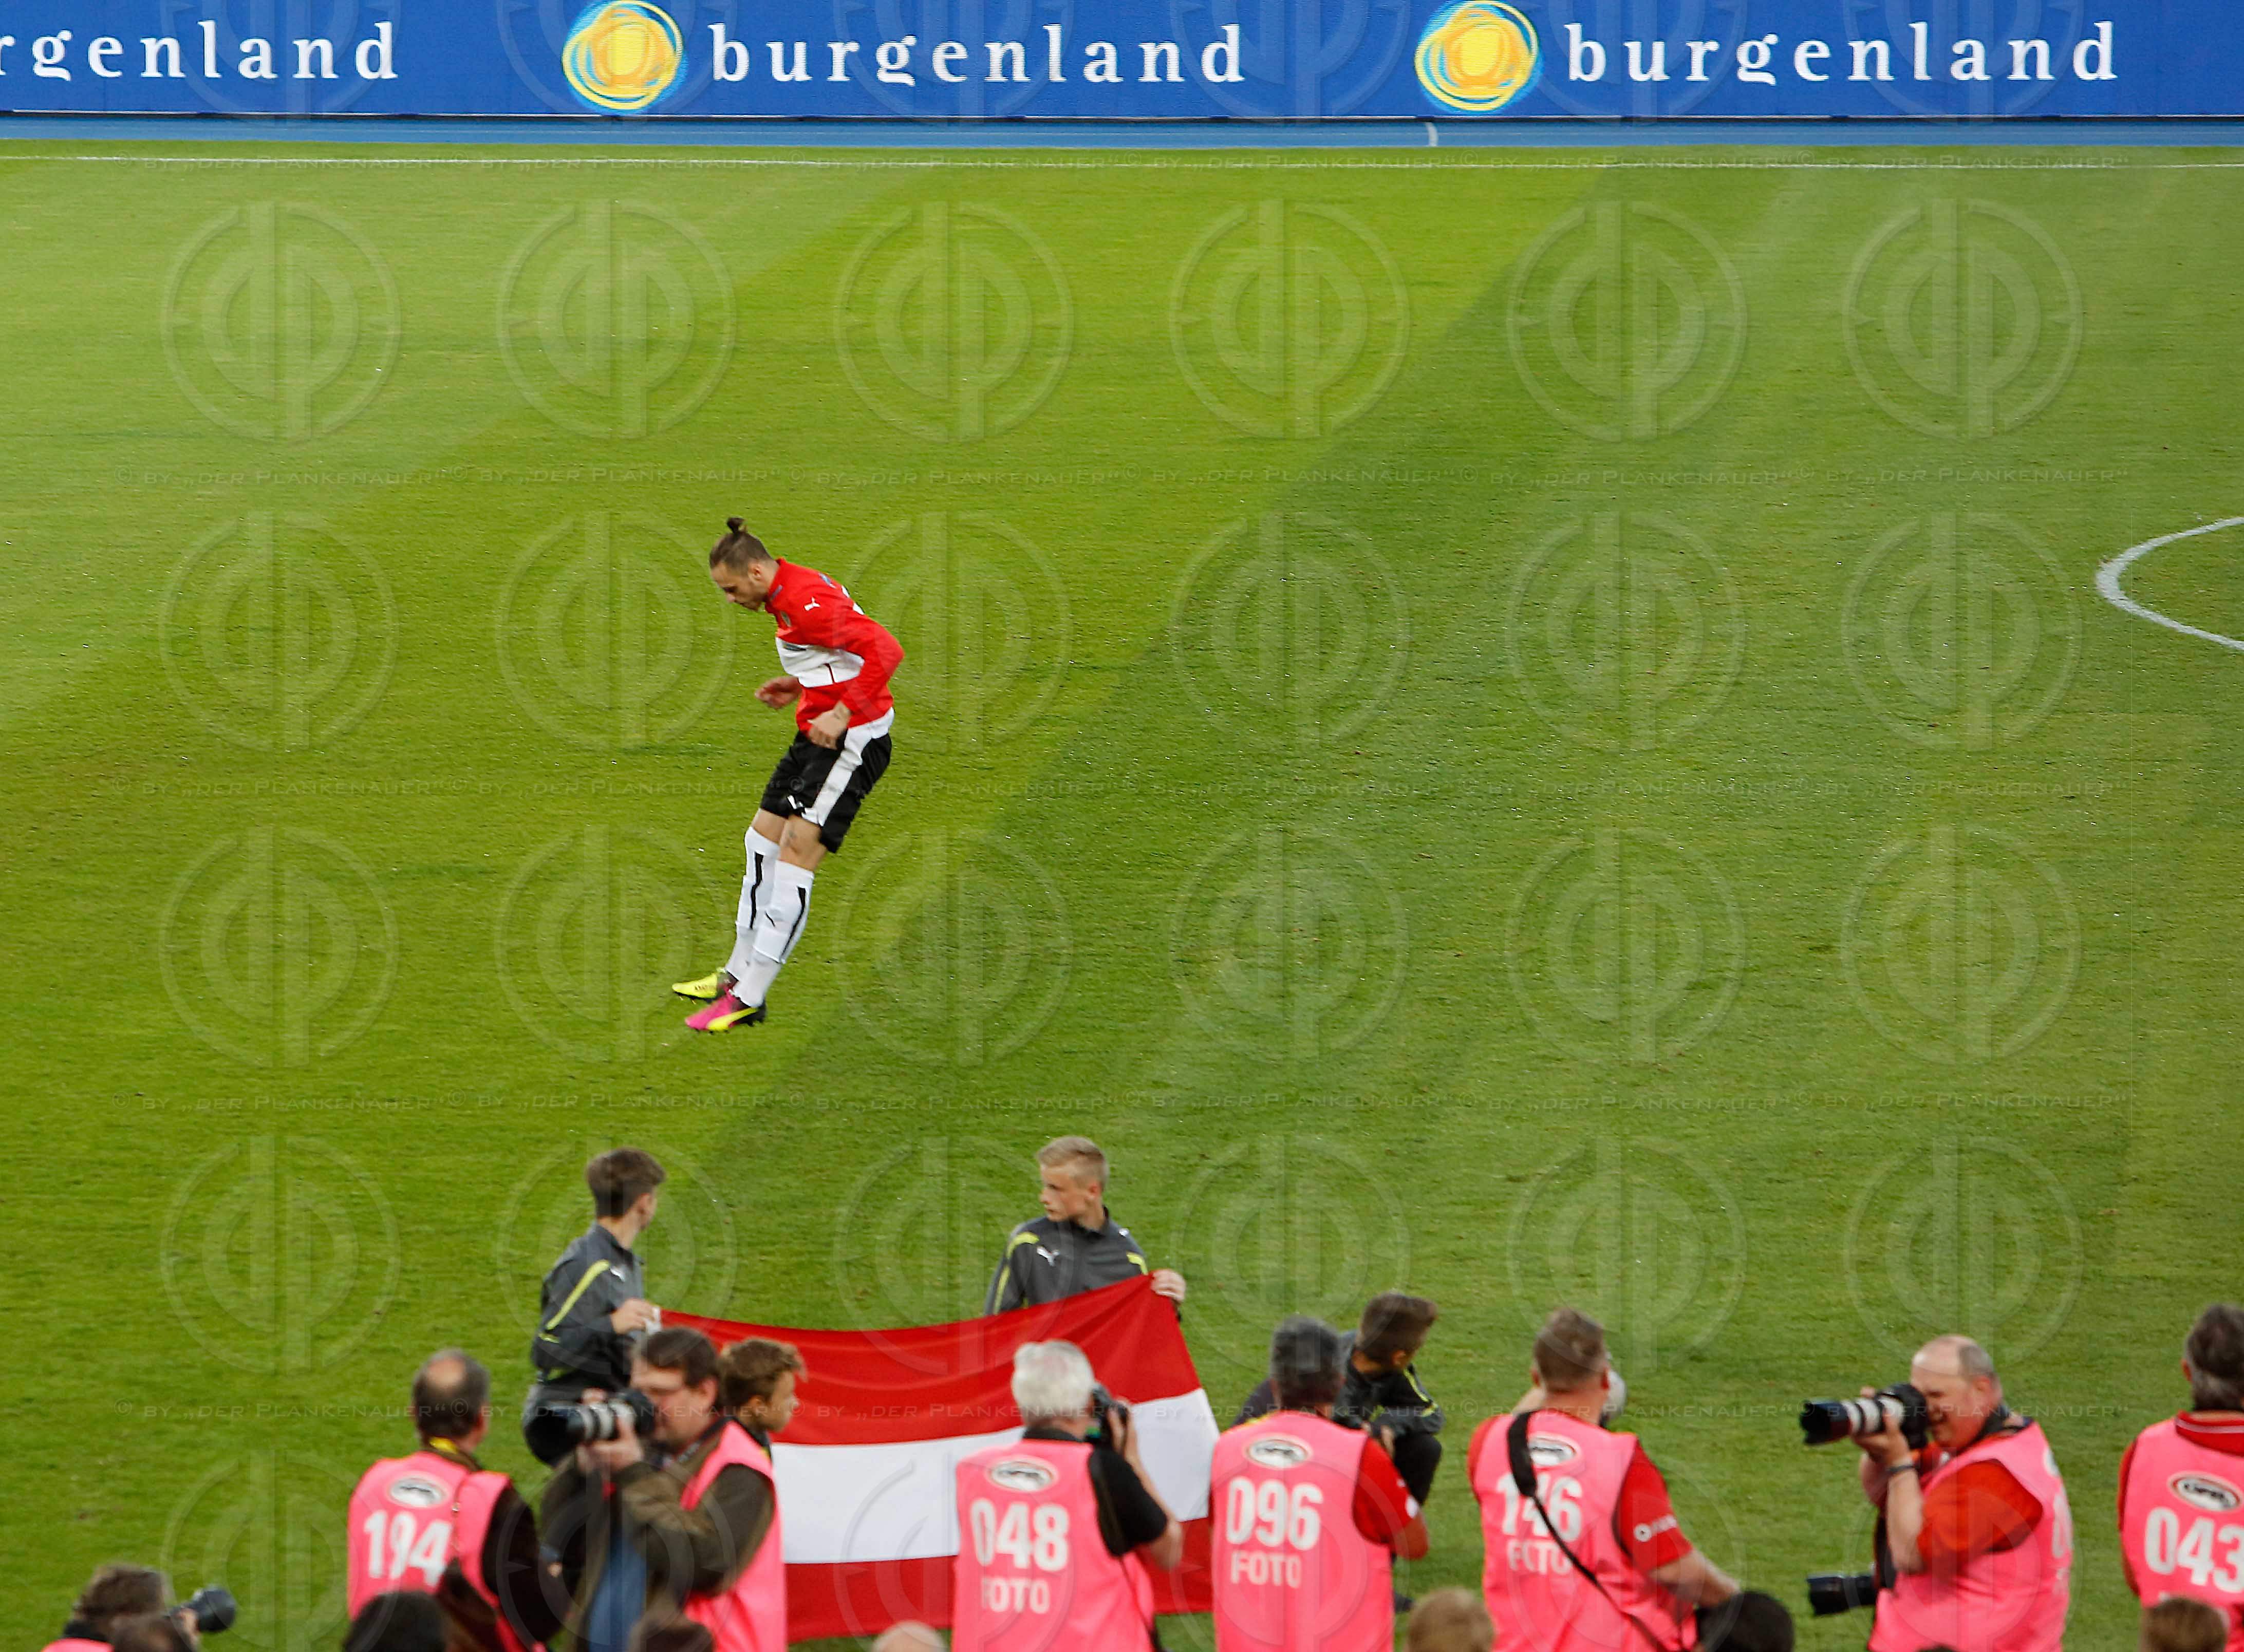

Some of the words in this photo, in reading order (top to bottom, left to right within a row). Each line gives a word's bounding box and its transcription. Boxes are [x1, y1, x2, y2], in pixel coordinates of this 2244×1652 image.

[708, 24, 1244, 86] burgenland
[1564, 21, 2117, 85] burgenland
[364, 1509, 453, 1587] 194
[970, 1497, 1069, 1572] 048
[1226, 1476, 1324, 1551] 096
[2144, 1506, 2244, 1593] 043
[1230, 1551, 1301, 1588] FOTO
